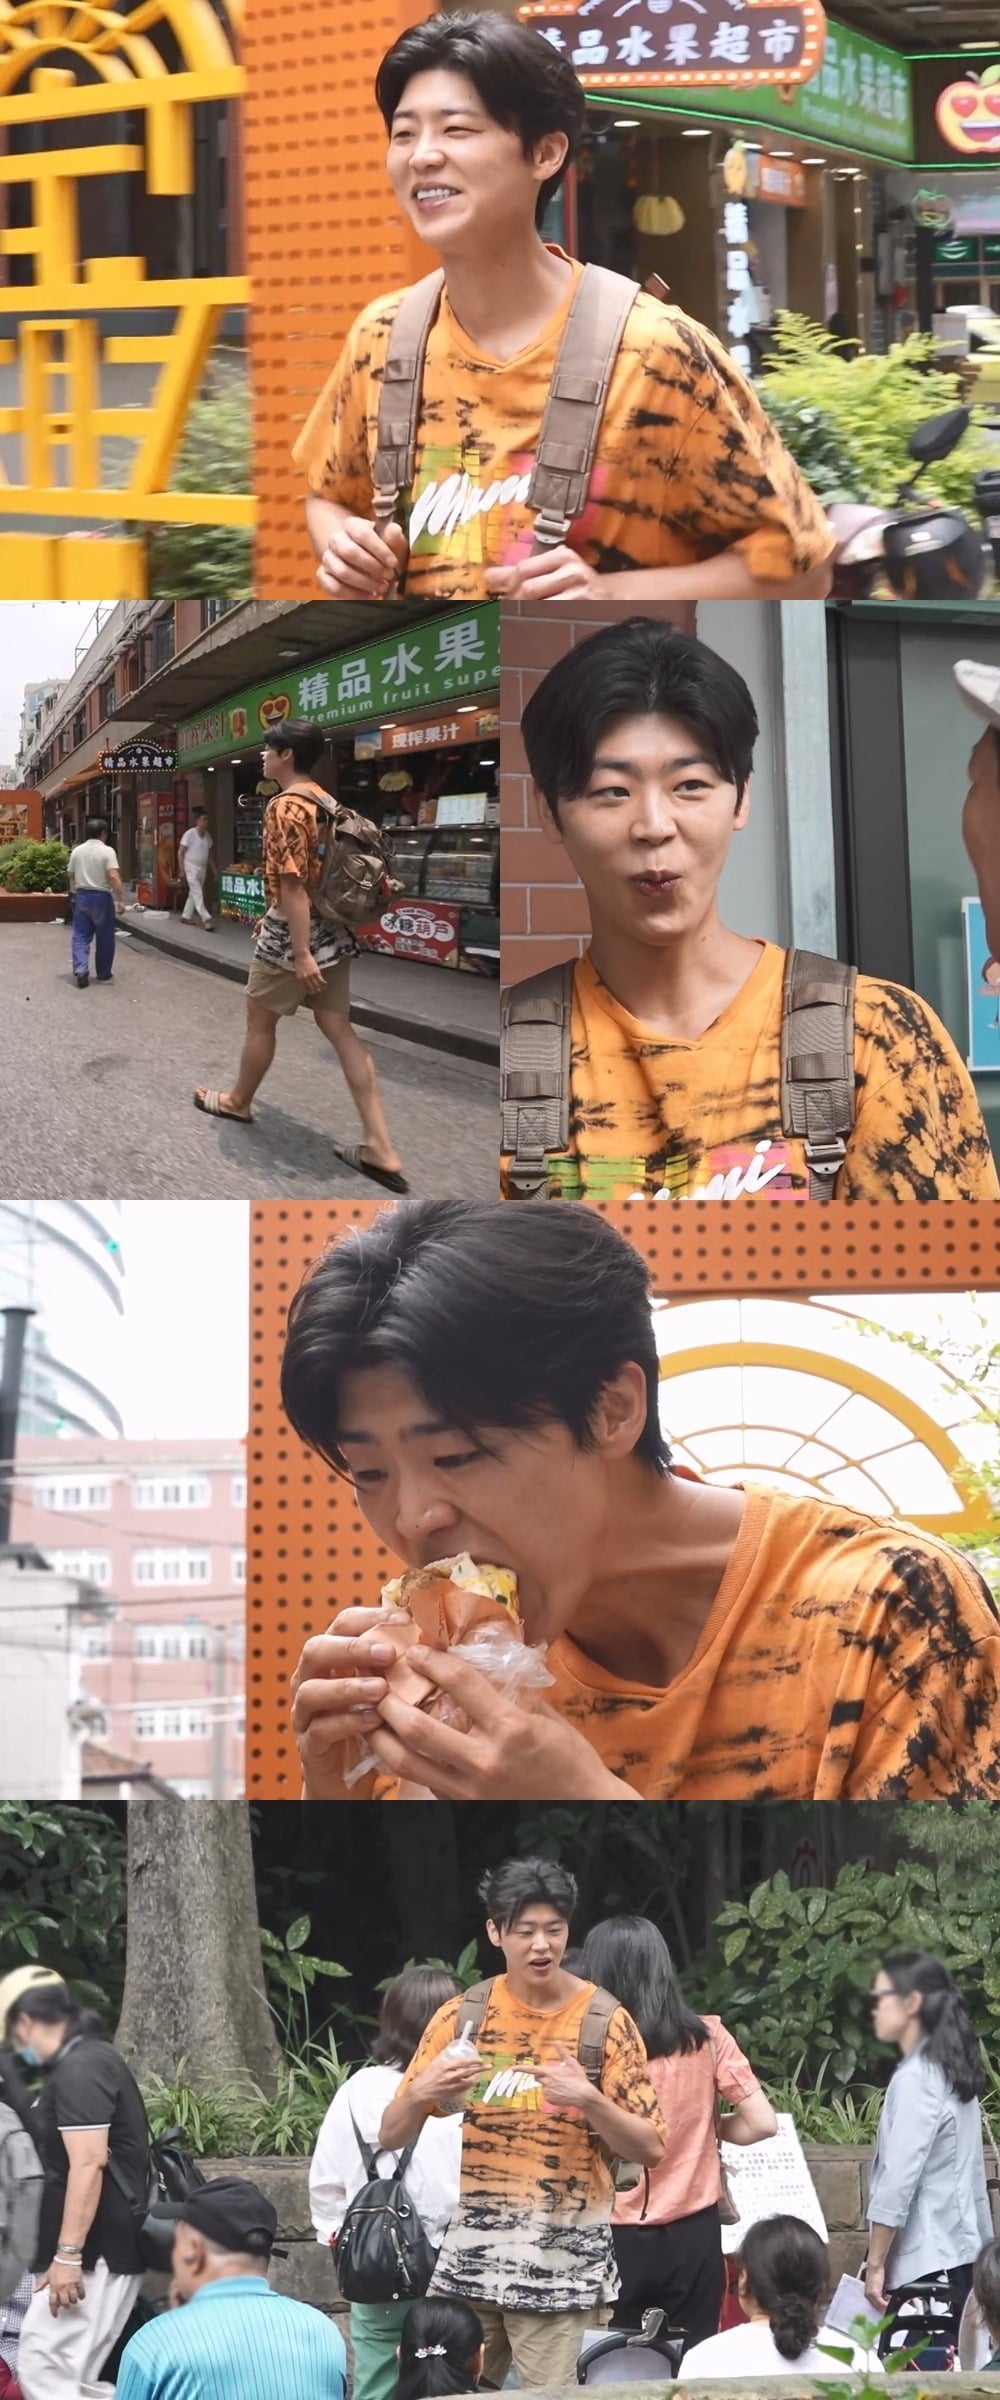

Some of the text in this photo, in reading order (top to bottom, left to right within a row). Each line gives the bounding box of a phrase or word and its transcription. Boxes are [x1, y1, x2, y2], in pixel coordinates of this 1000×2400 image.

[804, 35, 907, 124] 品水果超市
[298, 619, 500, 711] 精品水果
[383, 683, 431, 705] fruit
[103, 755, 175, 768] 精品水果超市
[222, 875, 265, 897] 精品水
